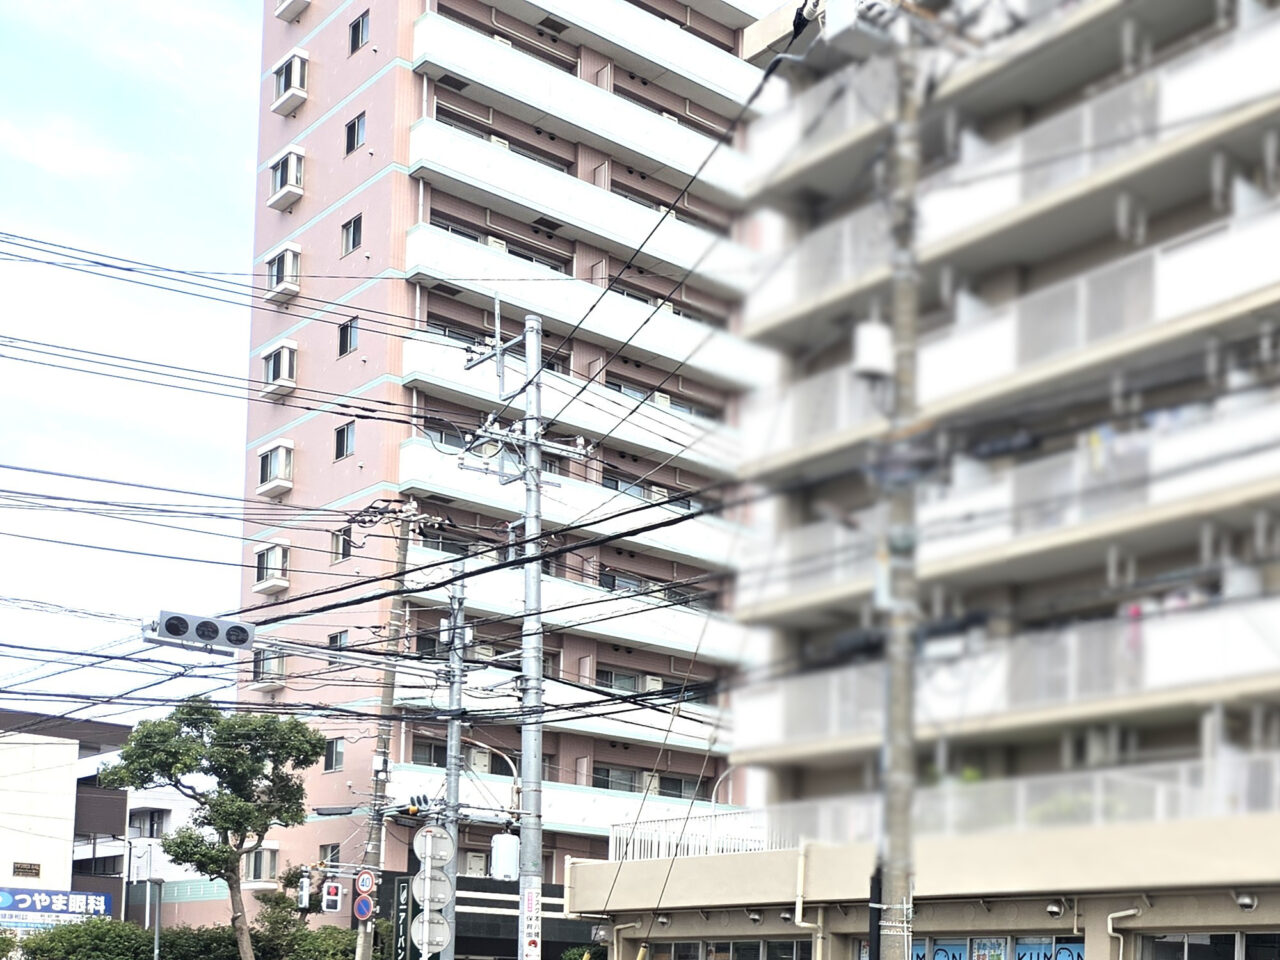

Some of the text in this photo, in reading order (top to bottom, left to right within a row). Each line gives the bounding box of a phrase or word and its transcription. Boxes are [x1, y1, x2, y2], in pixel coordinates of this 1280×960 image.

[360, 877, 371, 888] 40
[14, 892, 106, 914] つやま眼科
